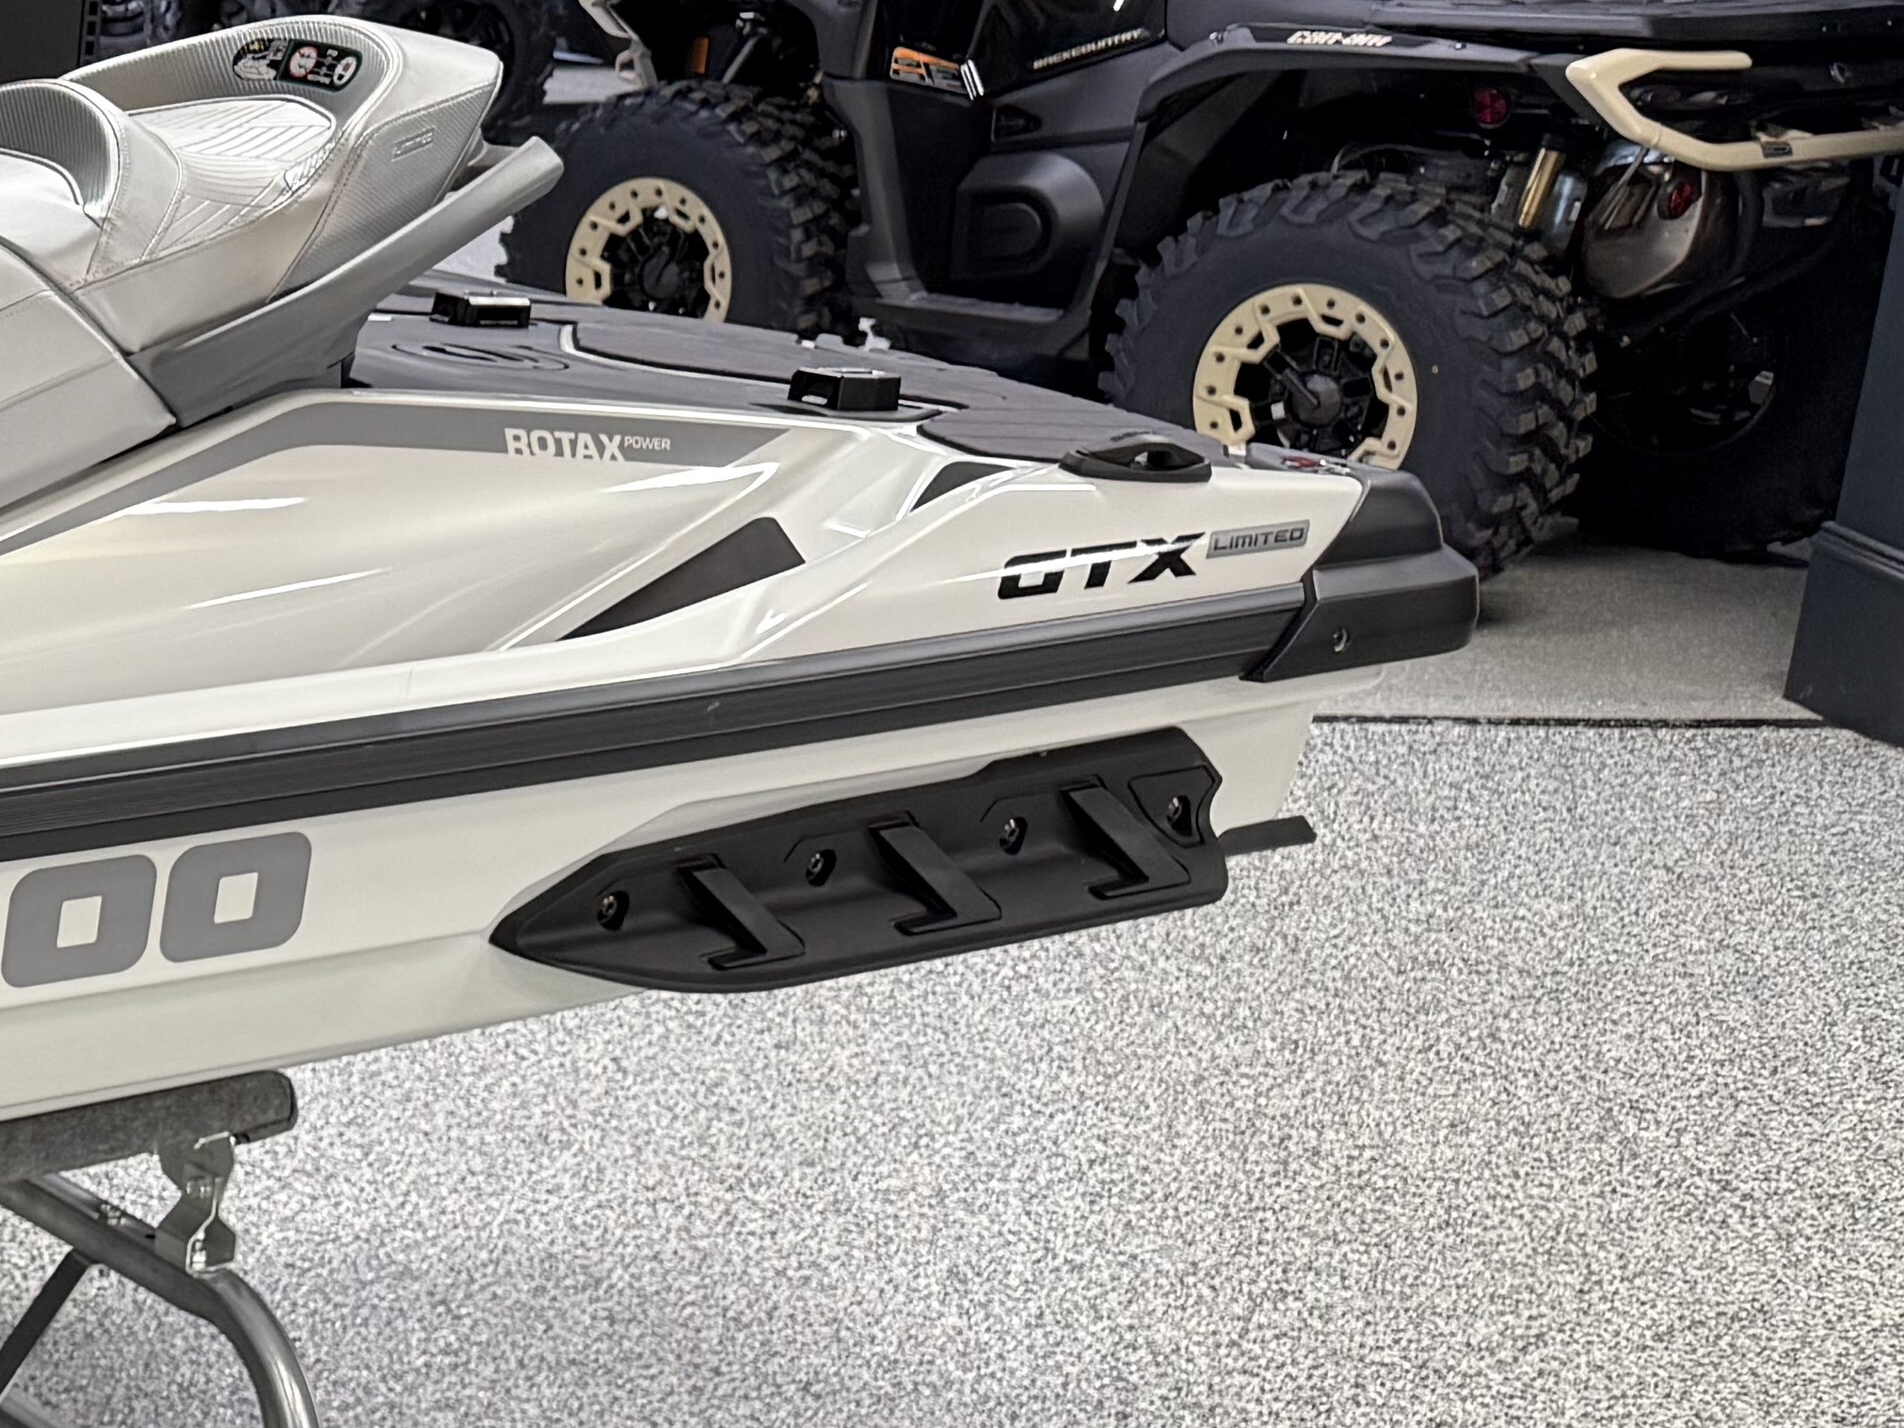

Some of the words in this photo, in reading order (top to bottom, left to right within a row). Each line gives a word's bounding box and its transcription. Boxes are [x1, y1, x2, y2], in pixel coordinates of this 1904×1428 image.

[504, 428, 626, 462] ROTAX
[624, 436, 672, 451] POWER
[998, 532, 1206, 600] GTX
[1213, 527, 1305, 552] LIMITED
